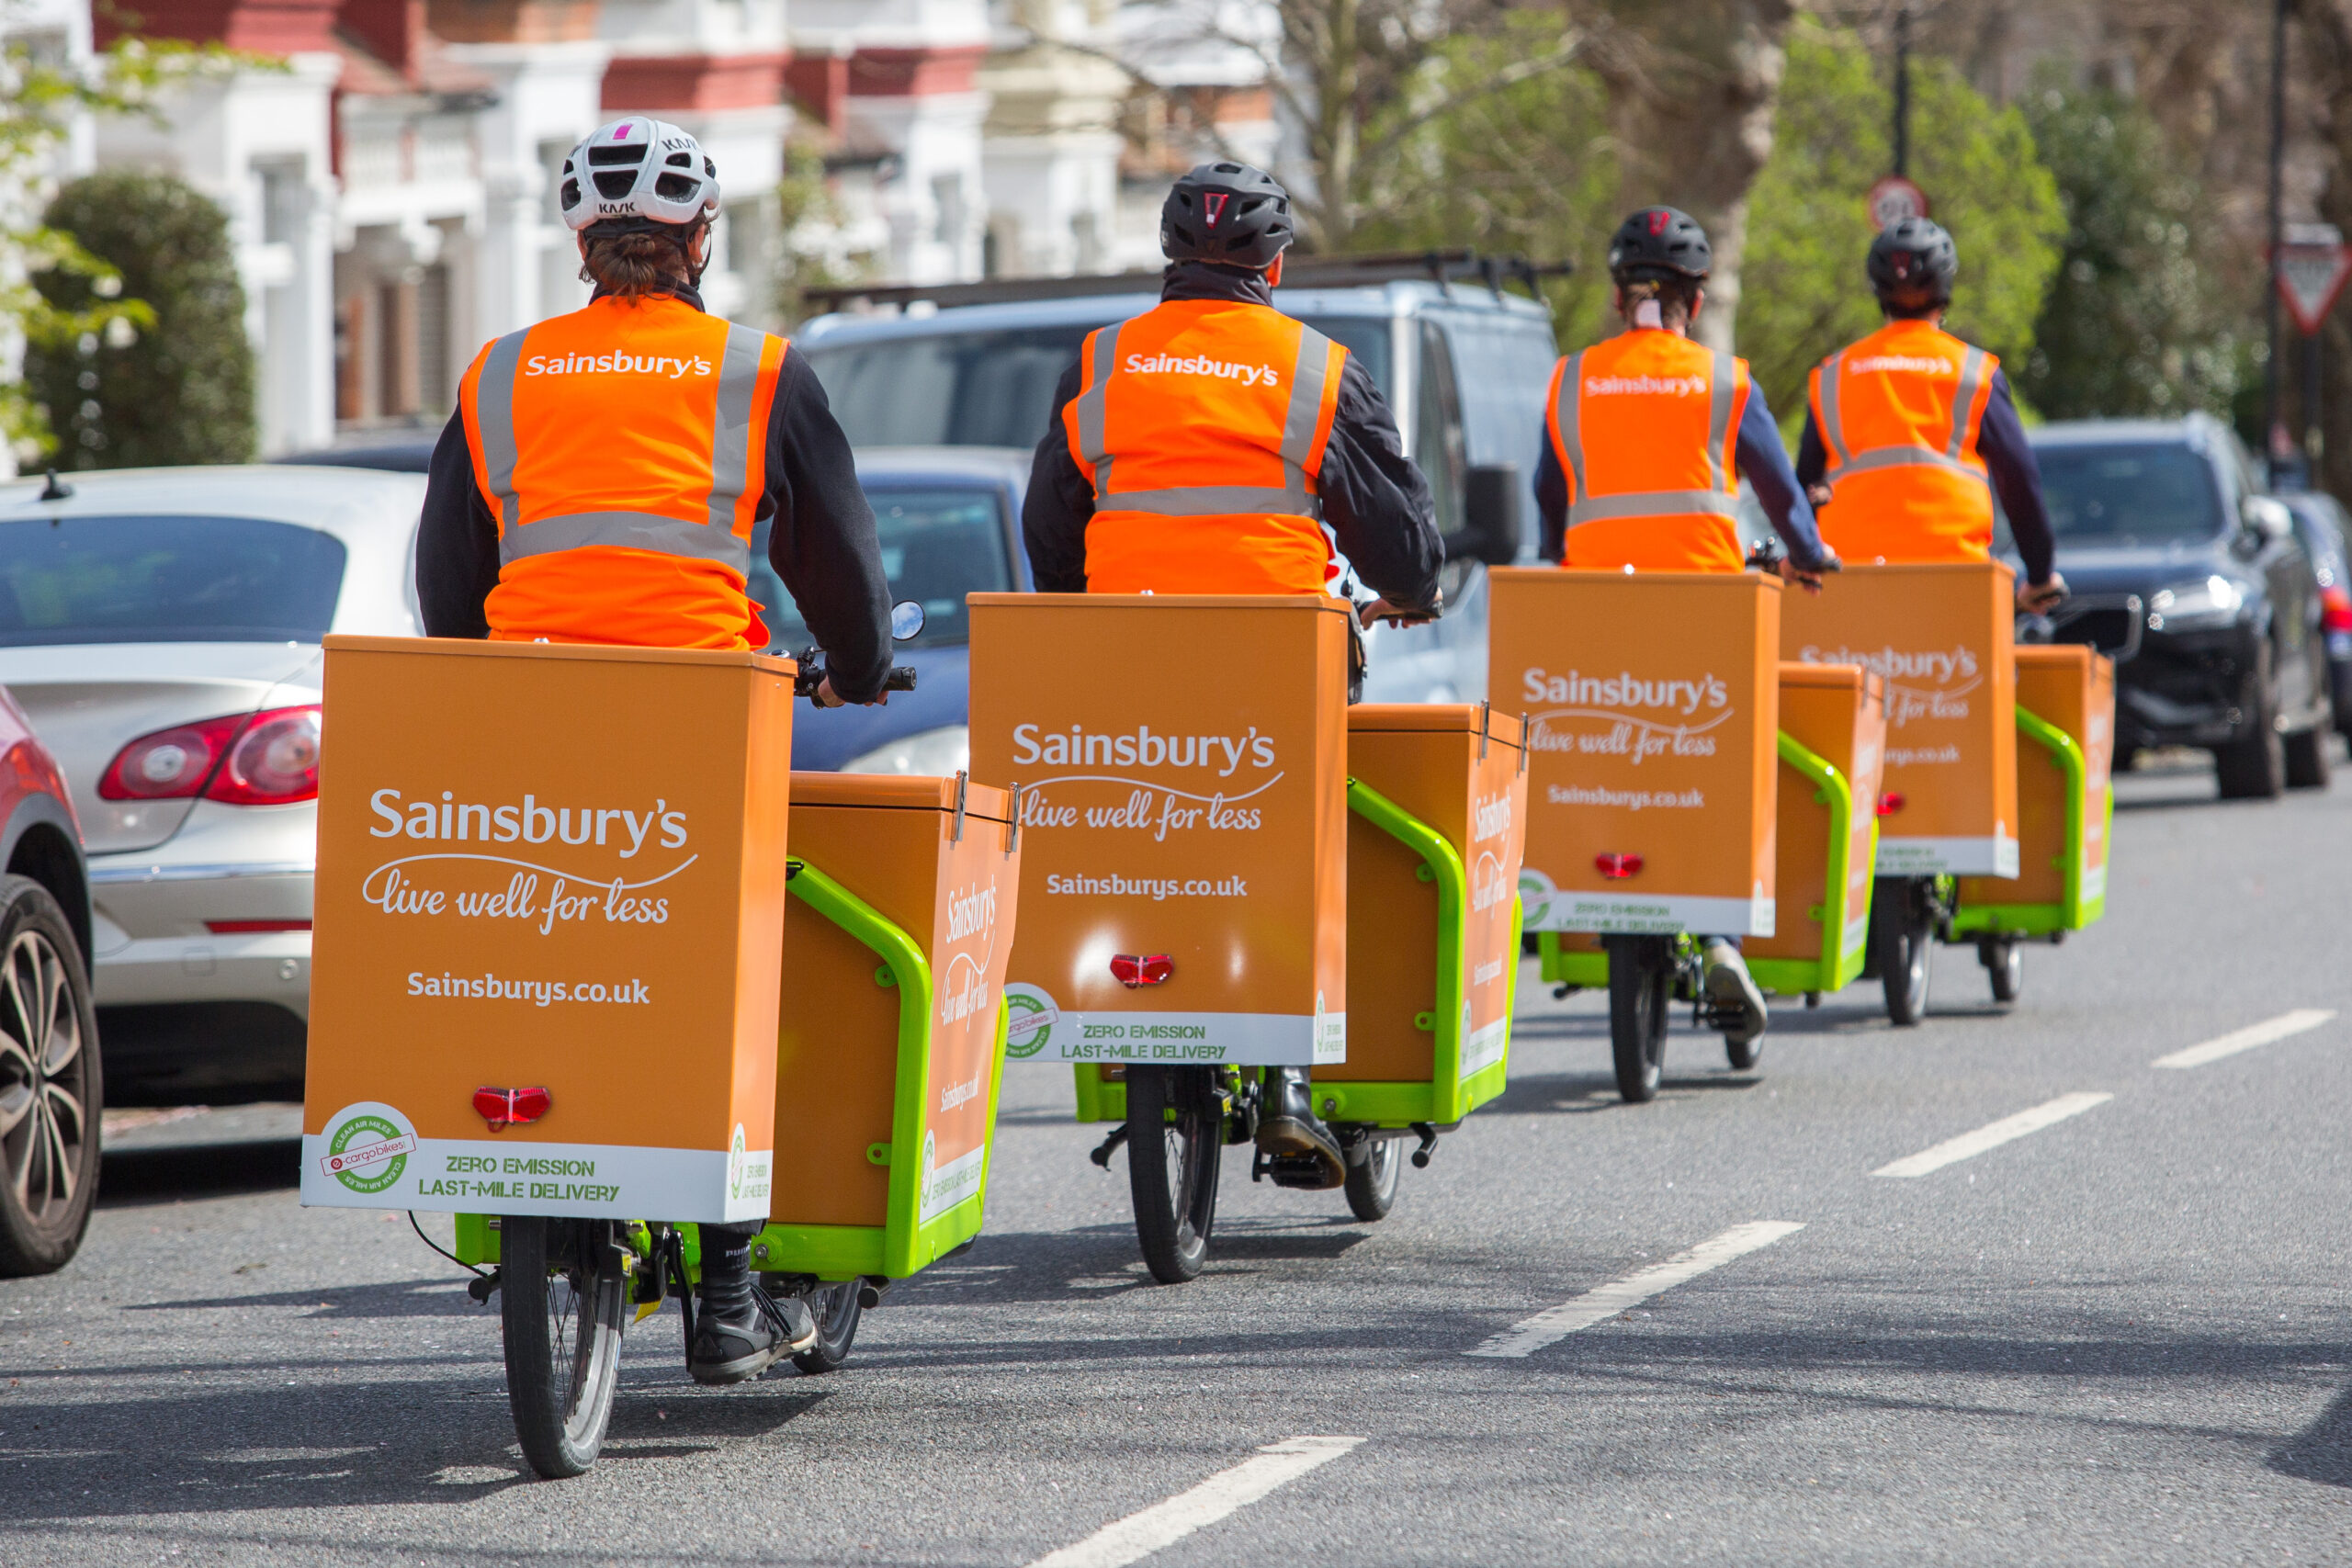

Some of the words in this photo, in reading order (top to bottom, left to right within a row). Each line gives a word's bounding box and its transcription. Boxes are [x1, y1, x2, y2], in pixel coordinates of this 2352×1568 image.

[599, 202, 635, 214] KASK
[526, 349, 712, 378] Sainsbury's
[1124, 352, 1278, 388] Sainsbury's
[1522, 667, 1727, 716] Sainsbury's
[1012, 723, 1275, 777] Sainsbury's
[1530, 719, 1574, 752] live
[1577, 720, 1632, 754] well
[1632, 724, 1671, 765] for
[1672, 723, 1716, 756] less
[1547, 784, 1705, 811] Sainsburys.co.uk
[369, 788, 688, 859] Sainsbury's
[1022, 789, 1080, 828] live
[1085, 789, 1153, 829] well
[1154, 794, 1203, 842] for
[1206, 792, 1261, 829] less
[1046, 874, 1248, 901] Sainsburys.co.uk
[382, 868, 447, 915] live
[456, 872, 538, 919] well
[539, 878, 598, 936] for
[603, 876, 669, 924] less
[945, 874, 996, 944] Sainsbury's
[407, 971, 650, 1007] Sainsburys.co.uk
[1083, 1025, 1125, 1039] ZERO
[1130, 1025, 1205, 1040] EMISSION
[1061, 1044, 1148, 1059] LAST-MILE
[1152, 1045, 1227, 1060] DELIVERY
[335, 1125, 355, 1149] CLEAN
[355, 1121, 368, 1130] AIR
[368, 1121, 392, 1135] MILES
[382, 1162, 402, 1185] CLEAN
[446, 1156, 498, 1174] ZERO
[503, 1157, 595, 1178] EMISSION
[345, 1176, 368, 1190] MILES
[369, 1180, 381, 1190] AIR
[418, 1179, 525, 1199] LAST-MILE
[529, 1182, 620, 1202] DELIVERY
